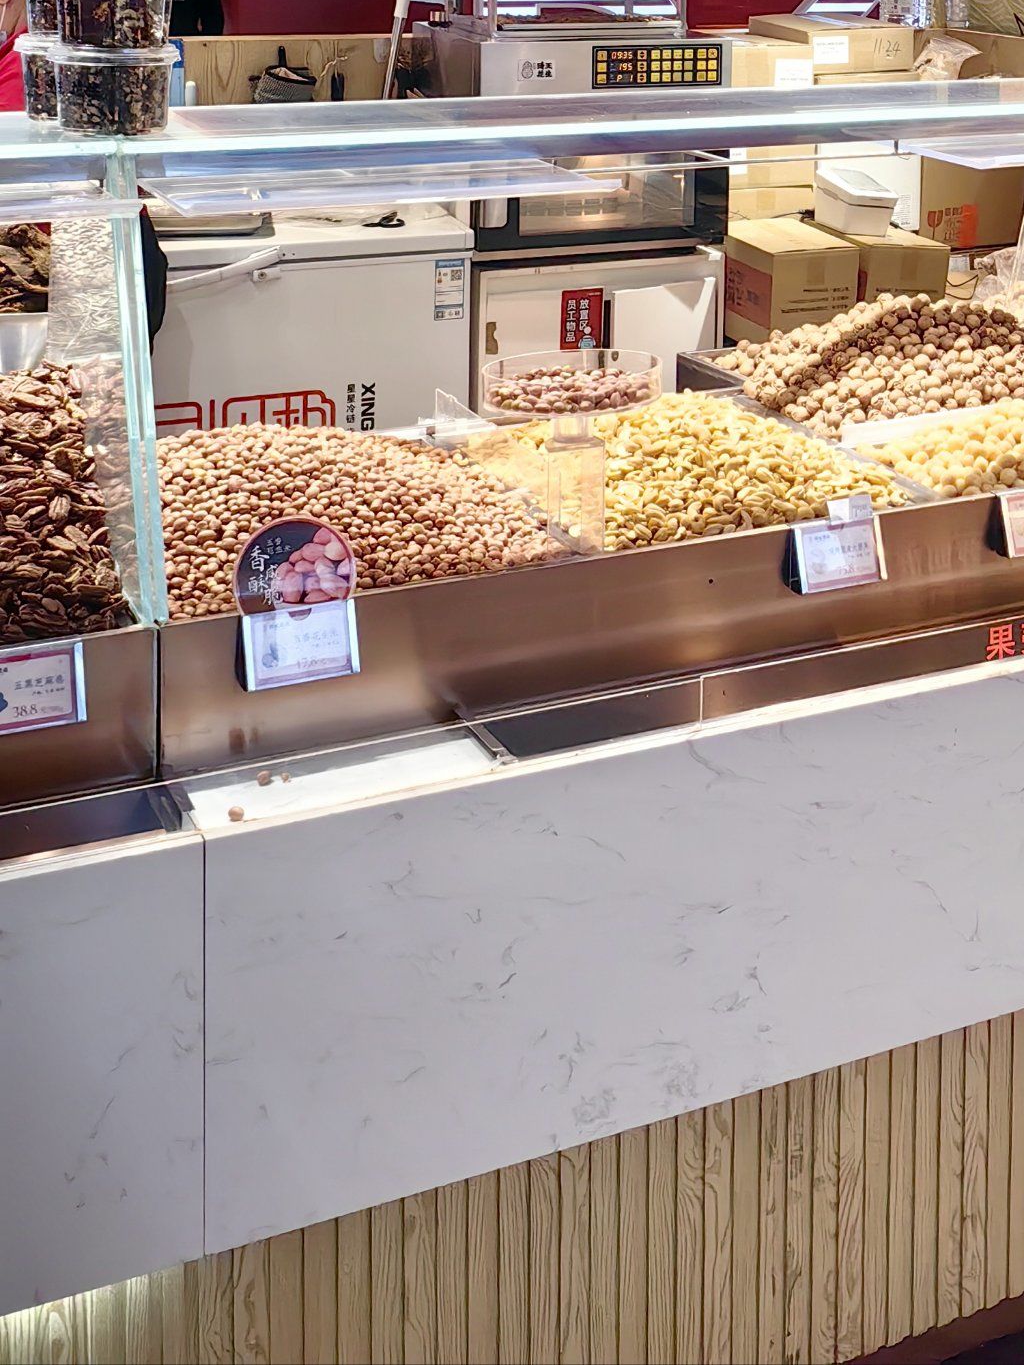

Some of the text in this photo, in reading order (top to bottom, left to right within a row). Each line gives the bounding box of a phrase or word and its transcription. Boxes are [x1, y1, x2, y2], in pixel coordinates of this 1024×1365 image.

[565, 299, 577, 343] 员工物品
[579, 299, 590, 331] 放置区
[346, 383, 356, 432] 星星冷链
